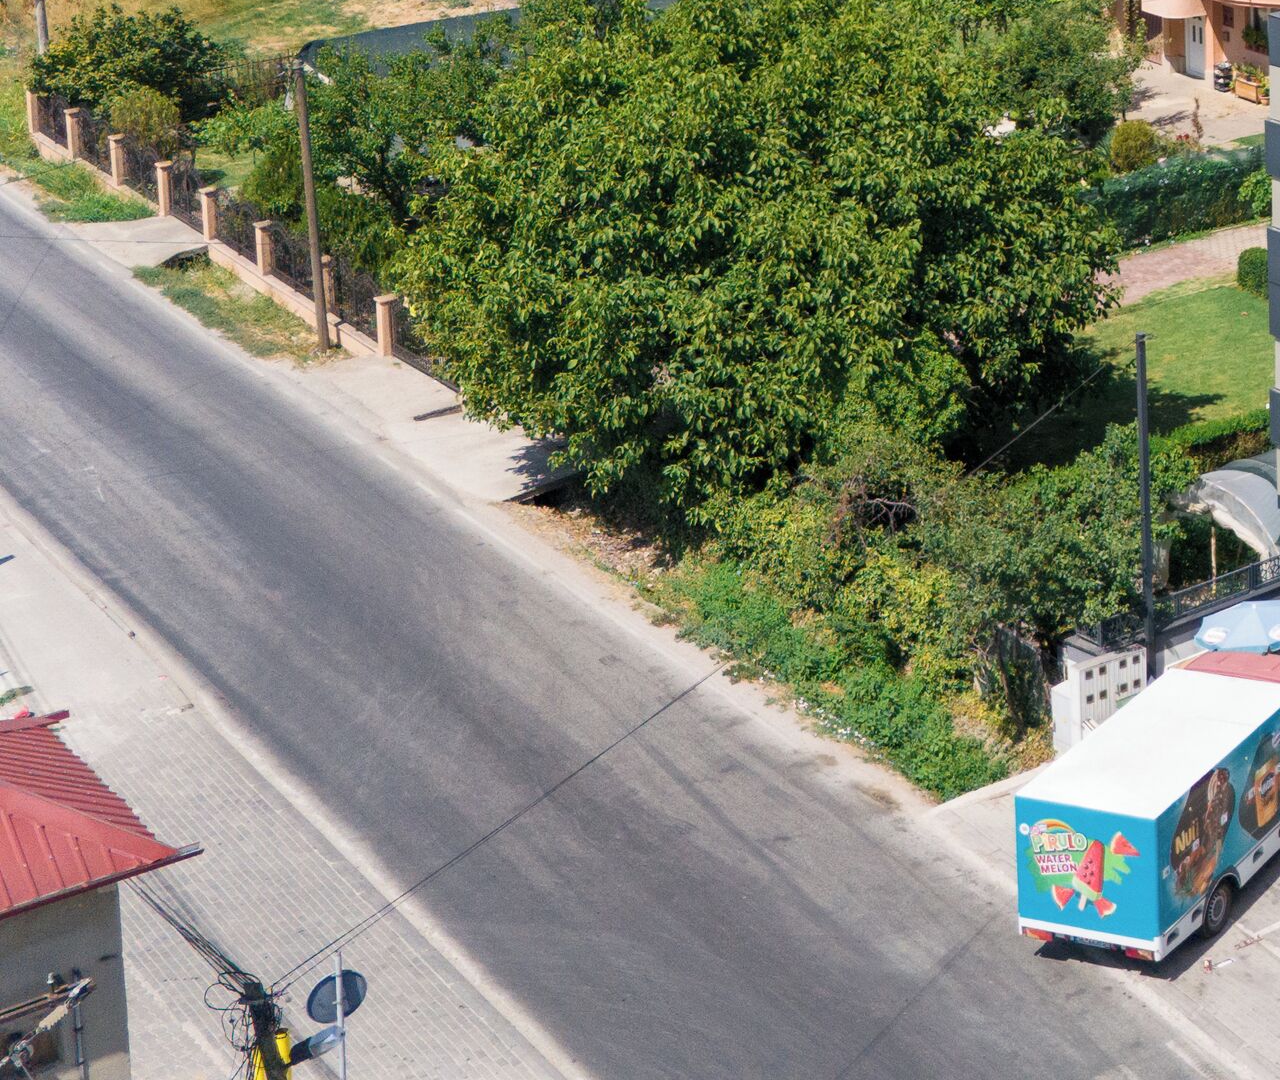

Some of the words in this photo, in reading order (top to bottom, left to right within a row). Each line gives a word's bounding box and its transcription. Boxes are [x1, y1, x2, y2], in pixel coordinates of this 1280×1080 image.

[1030, 832, 1088, 853] PIRULO
[1035, 853, 1072, 865] WATER
[1040, 863, 1078, 875] MELON
